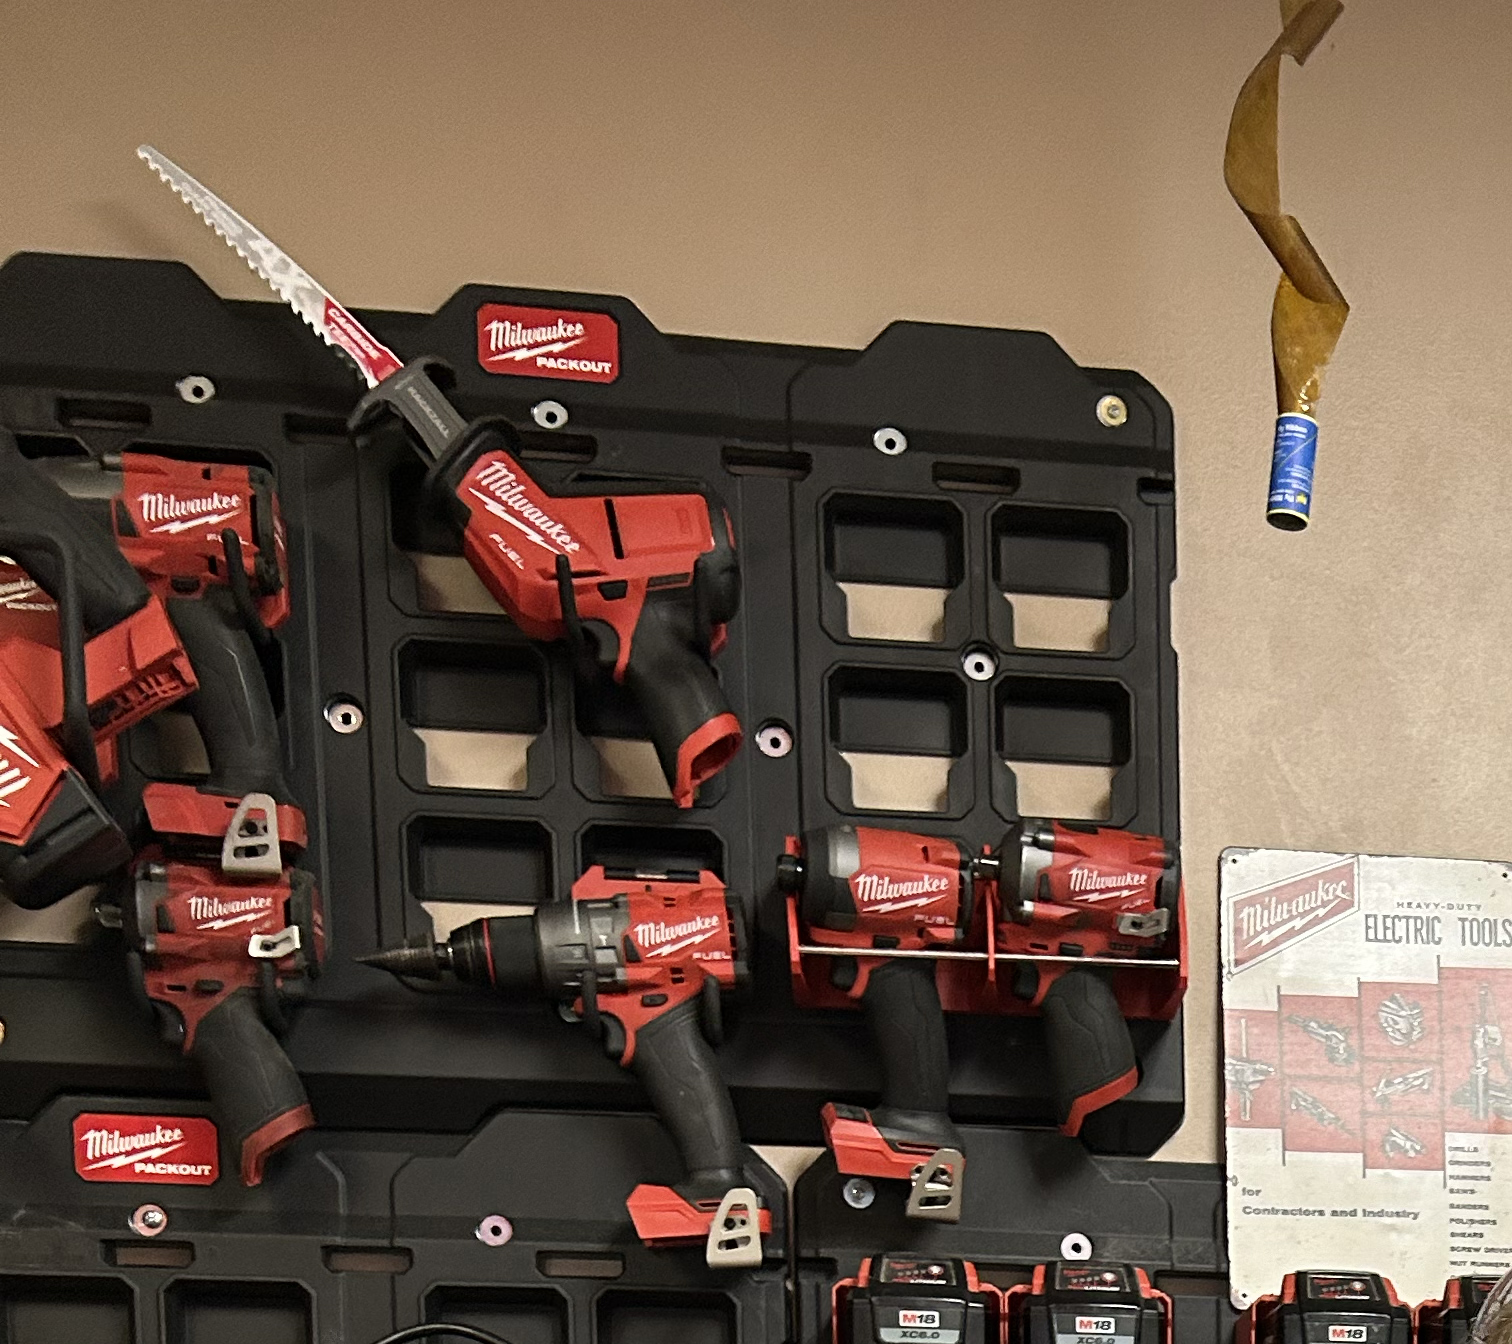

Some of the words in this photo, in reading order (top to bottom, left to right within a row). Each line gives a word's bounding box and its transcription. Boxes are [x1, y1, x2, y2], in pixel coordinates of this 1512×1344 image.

[484, 319, 586, 352] Milwaukee
[536, 356, 612, 374] PACKOUT
[136, 492, 242, 522] Milwaukee
[475, 460, 580, 555] Milwaukee
[489, 533, 525, 571] FUEL
[855, 874, 950, 902] Milwaukee
[1069, 867, 1148, 893] Milwaukee
[187, 895, 273, 920] Milwaukee
[1240, 879, 1351, 938] Milwaukee
[1396, 901, 1482, 912] HEAVY-DUTY
[633, 914, 719, 948] Milwaukee
[913, 914, 955, 927] FUEL
[1365, 915, 1443, 946] ELECTRIC
[692, 950, 732, 961] FUEL
[80, 1125, 184, 1159] Milwaukee
[134, 1162, 212, 1176] PACKOUT
[1242, 1187, 1262, 1197] for
[1242, 1205, 1325, 1217] Contractors
[1330, 1208, 1358, 1218] and
[1362, 1208, 1420, 1221] Industry
[902, 1314, 936, 1324] M18
[1078, 1318, 1112, 1331] M18
[1331, 1328, 1364, 1339] M18
